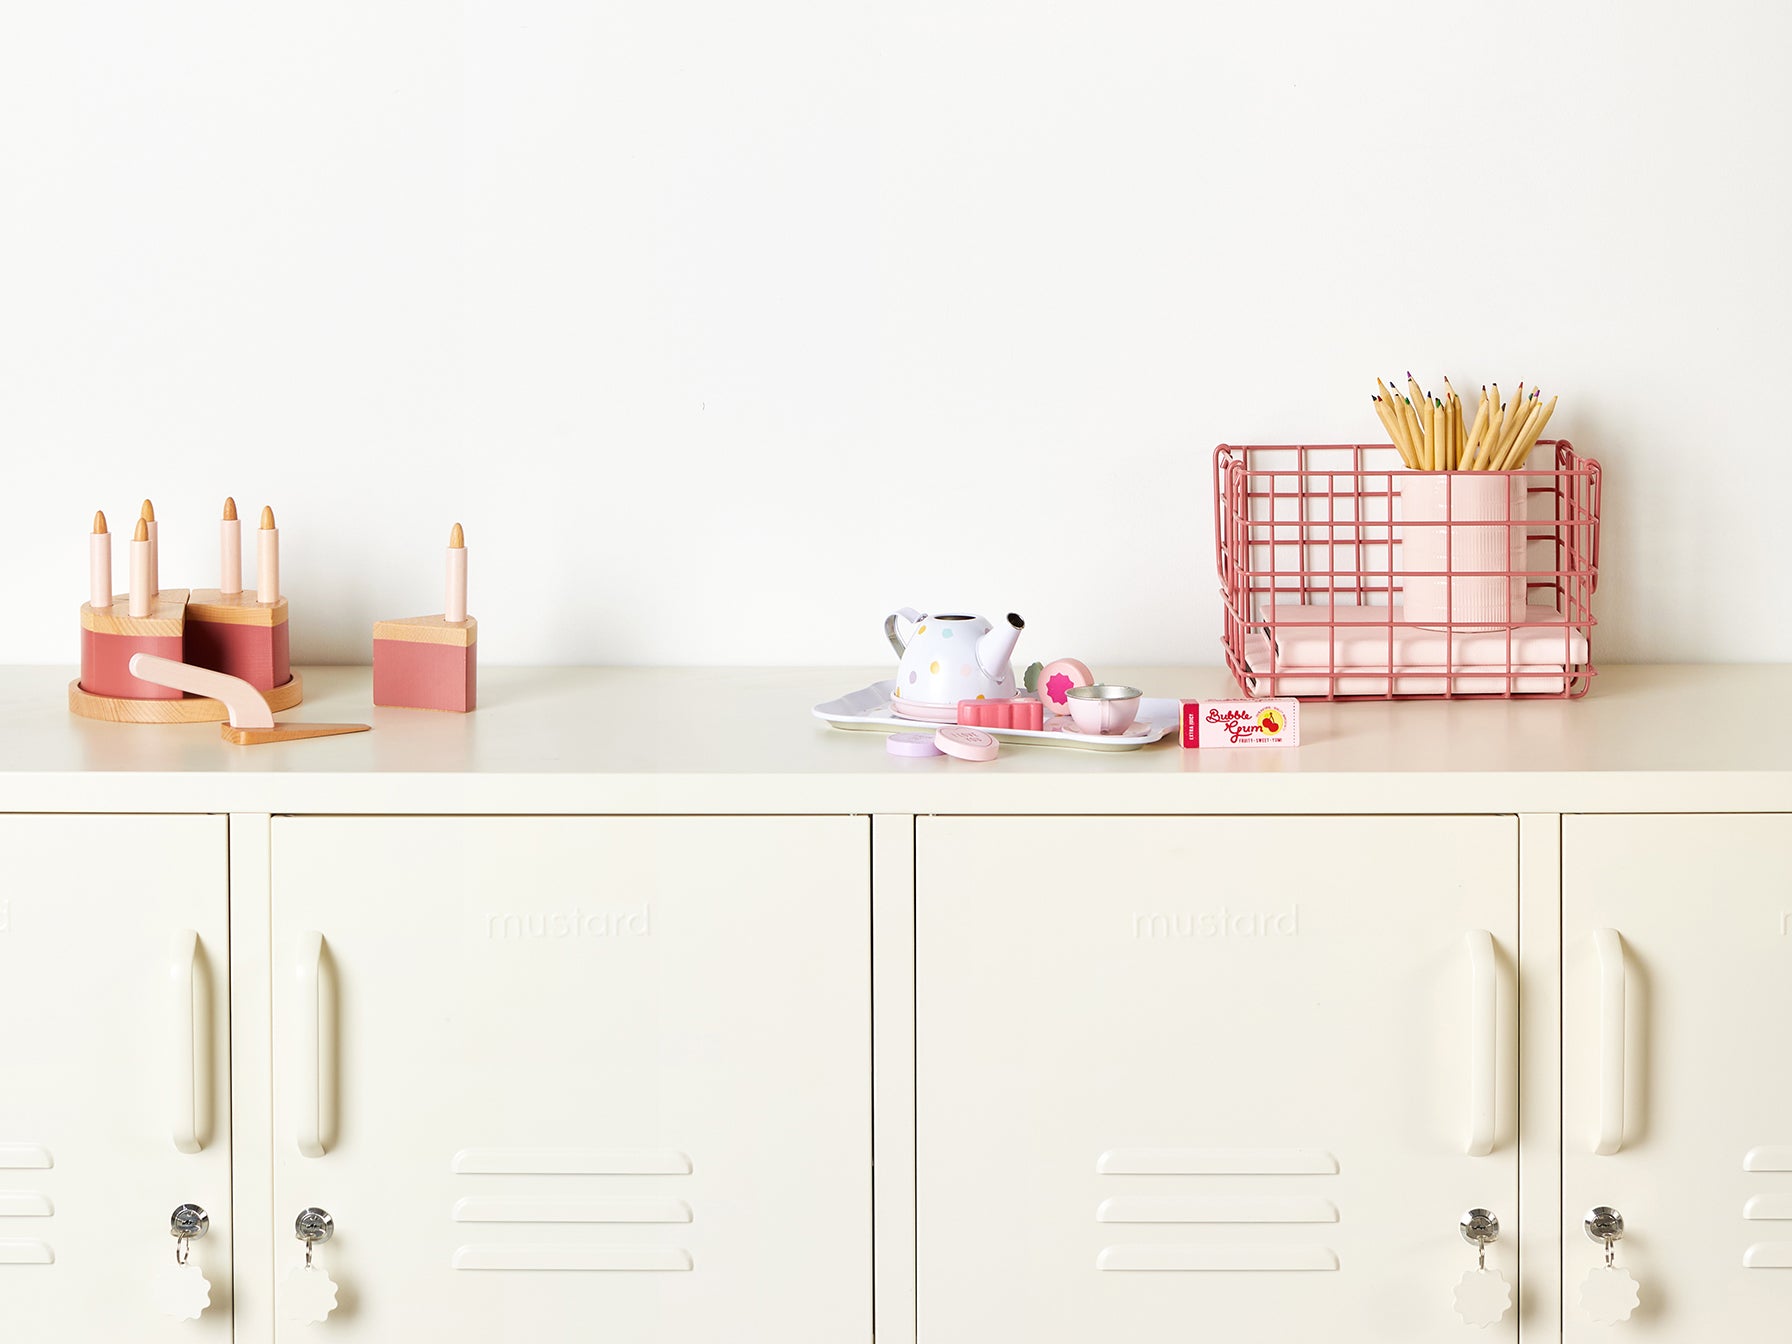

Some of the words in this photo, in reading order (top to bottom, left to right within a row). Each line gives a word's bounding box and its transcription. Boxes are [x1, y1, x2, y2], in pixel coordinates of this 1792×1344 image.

[1205, 708, 1253, 723] Bubble
[1224, 720, 1264, 743] Gum
[485, 903, 652, 939] mustard
[1132, 903, 1301, 939] mustard
